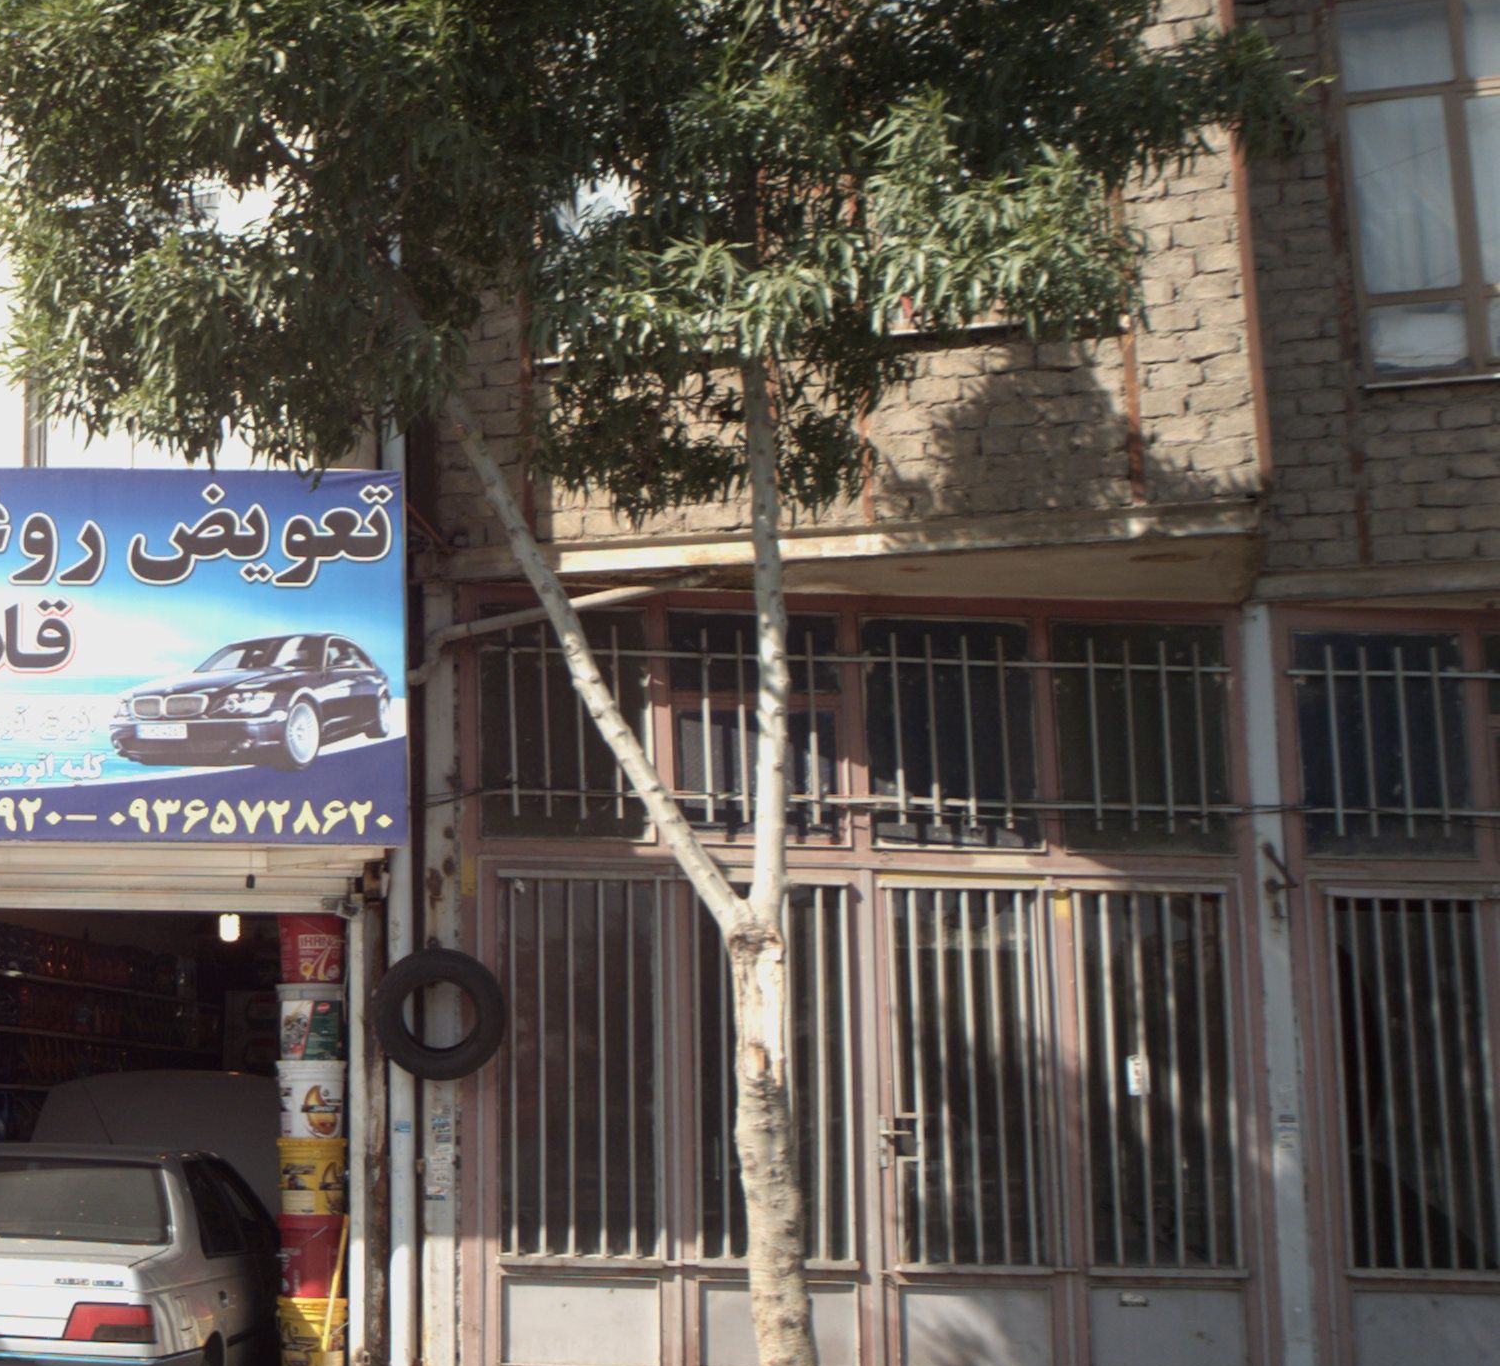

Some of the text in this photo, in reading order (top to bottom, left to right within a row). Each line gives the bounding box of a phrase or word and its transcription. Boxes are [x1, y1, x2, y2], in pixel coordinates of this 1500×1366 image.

[127, 483, 393, 587] تعویض
[59, 751, 108, 787] کلیه
[108, 797, 394, 835] ۰۹۳۶۵۷۲۸۶۲۰
